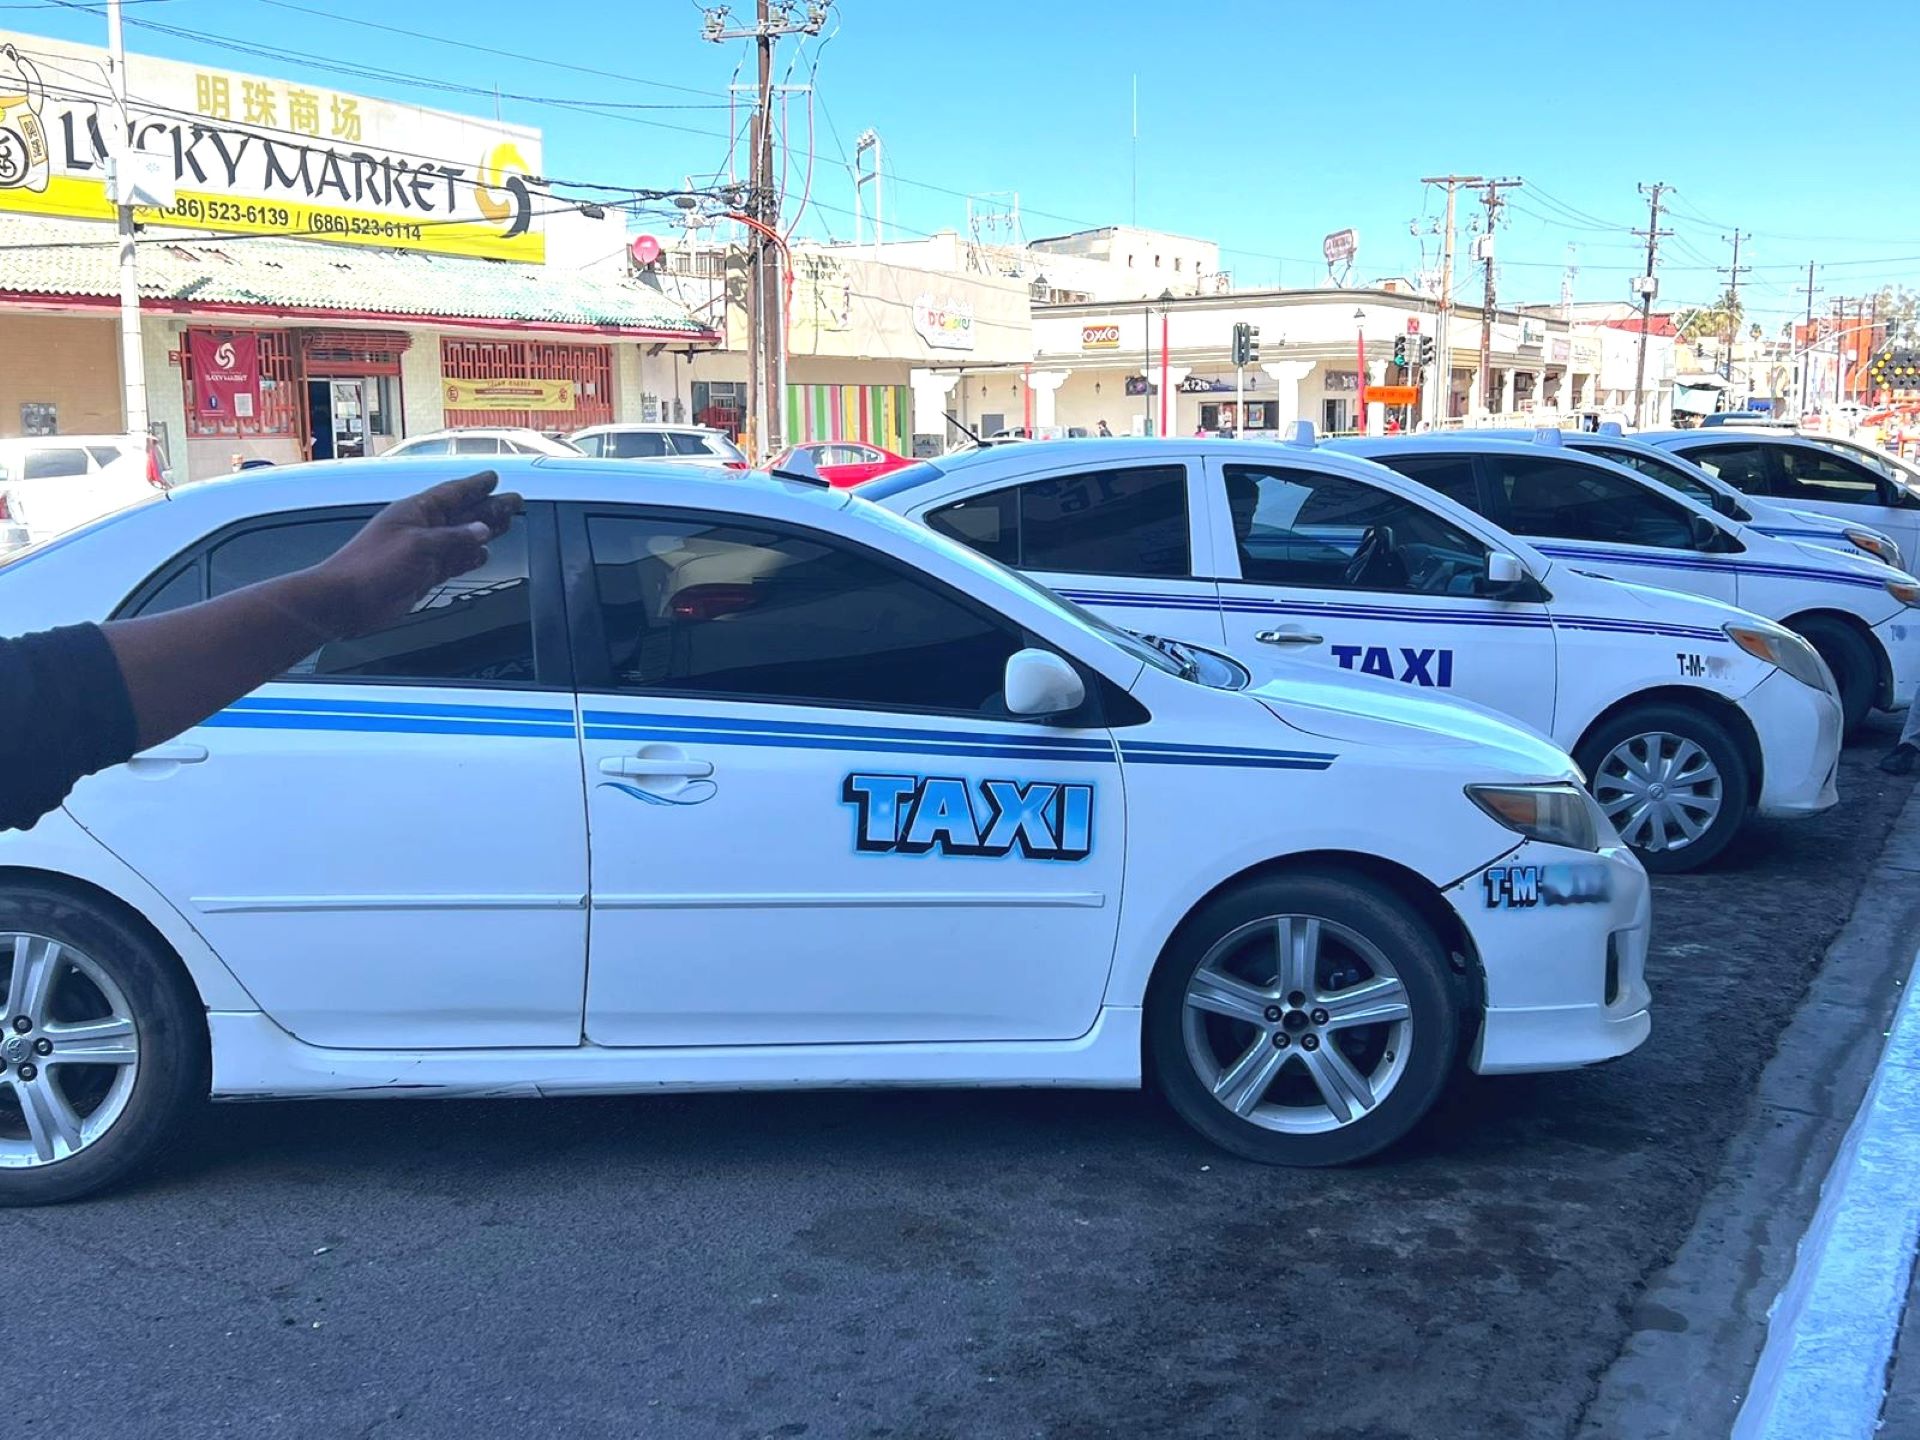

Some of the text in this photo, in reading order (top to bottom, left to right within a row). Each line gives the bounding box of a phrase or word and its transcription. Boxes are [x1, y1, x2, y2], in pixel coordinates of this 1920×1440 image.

[196, 74, 361, 141] 明珠商场
[263, 136, 465, 213] MARKET
[1331, 645, 1453, 687] TAXI
[842, 774, 1094, 861] TAXI
